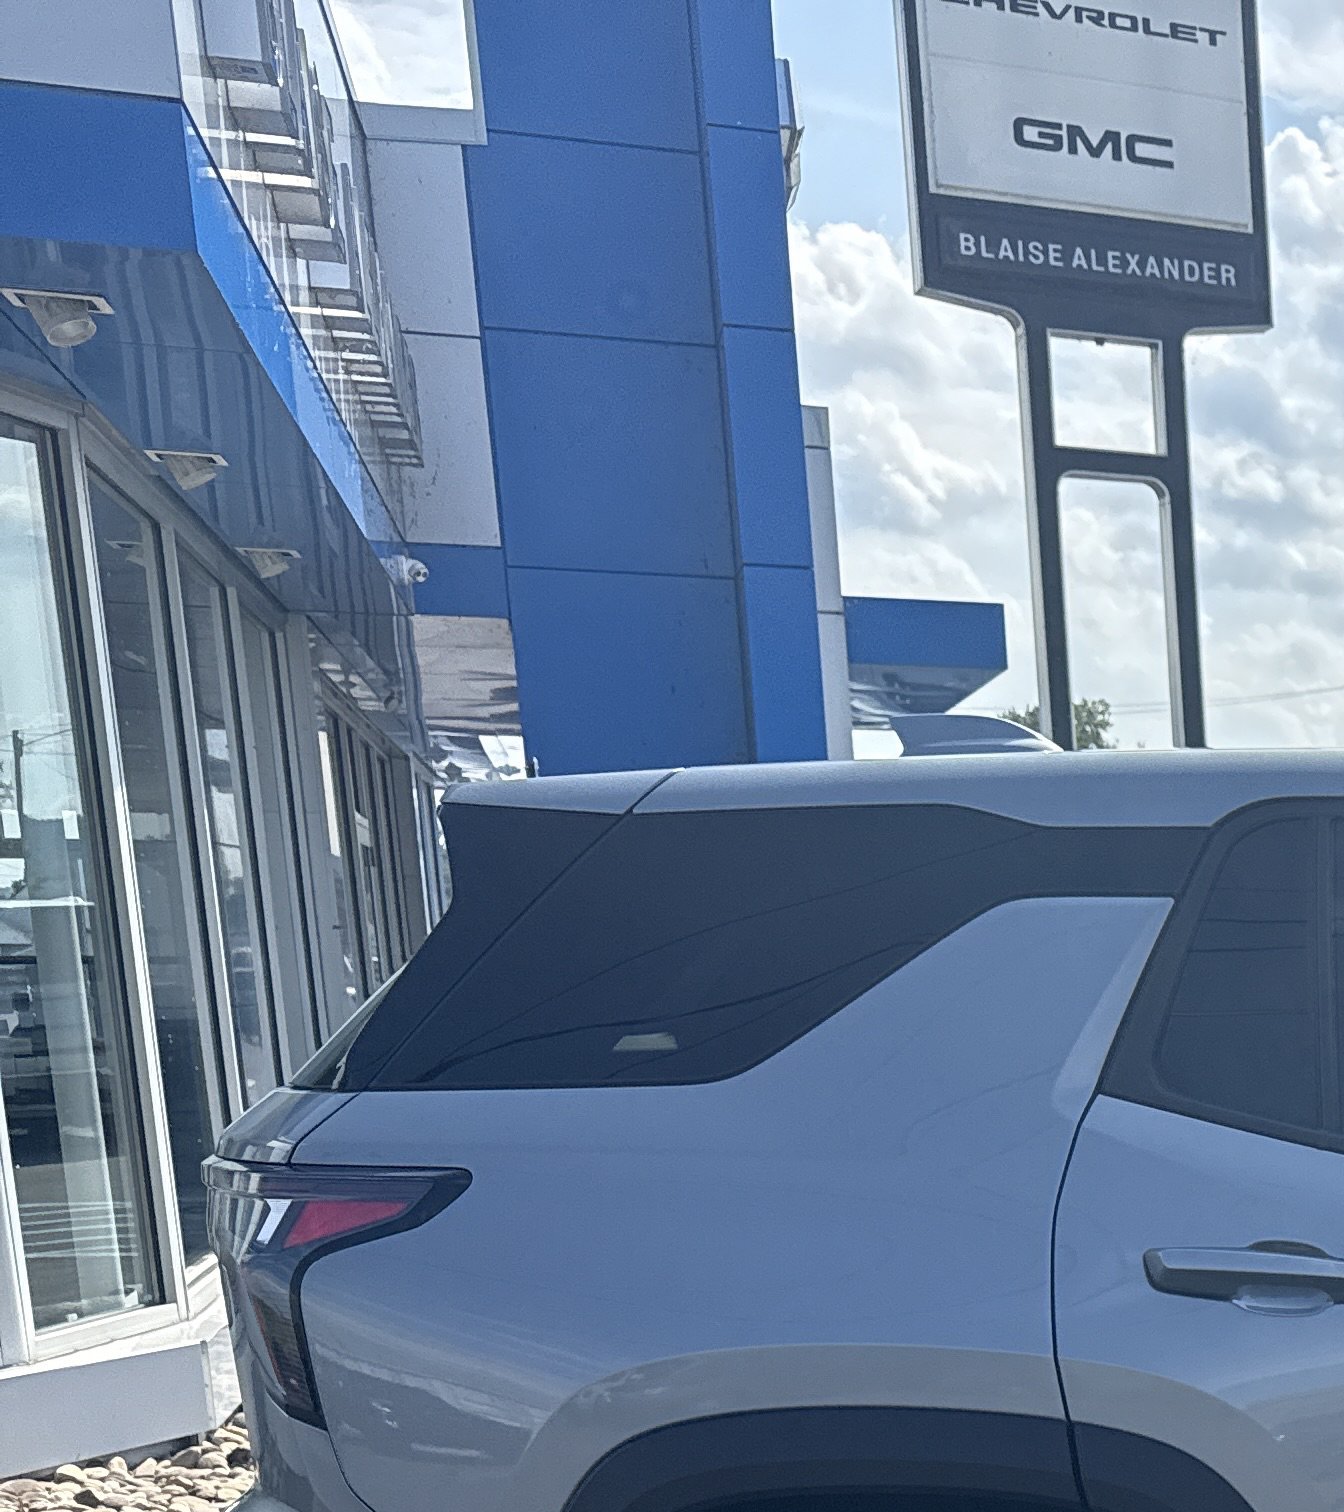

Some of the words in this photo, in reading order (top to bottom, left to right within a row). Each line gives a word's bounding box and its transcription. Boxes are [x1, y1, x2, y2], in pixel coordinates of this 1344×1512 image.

[939, 0, 1227, 47] EVROLET
[1012, 116, 1175, 169] GMC
[959, 232, 1065, 268] BLAISE
[1071, 247, 1237, 287] ALEXANDER
